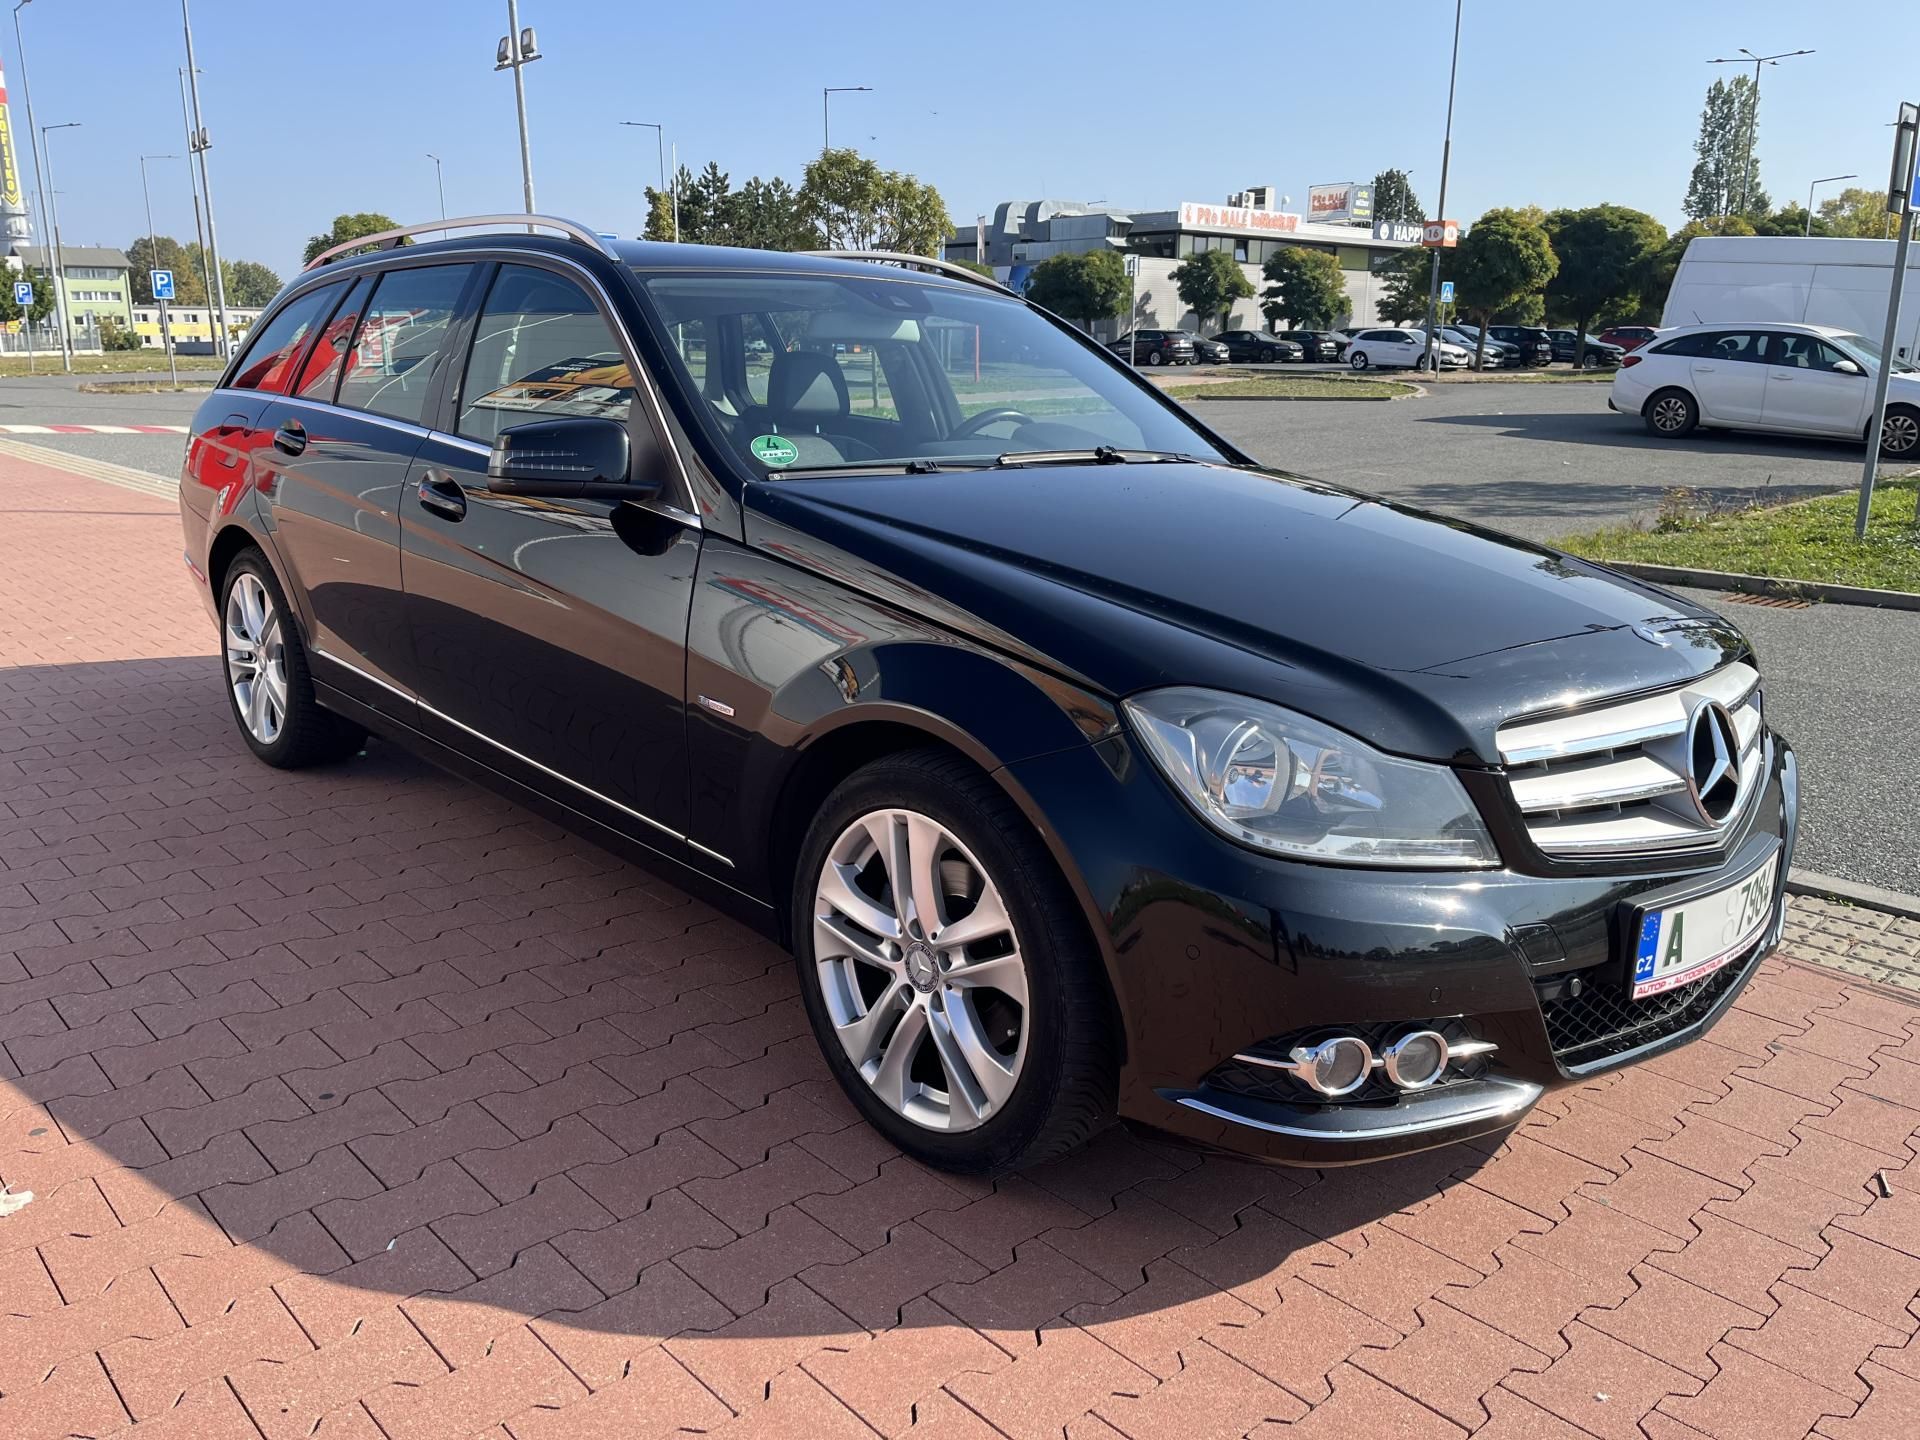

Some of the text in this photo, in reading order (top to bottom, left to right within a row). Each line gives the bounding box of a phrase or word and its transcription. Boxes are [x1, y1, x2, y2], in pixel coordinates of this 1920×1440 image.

[1428, 228, 1439, 239] 16
[155, 274, 169, 290] P
[18, 285, 29, 298] P
[1636, 955, 1653, 973] CZ
